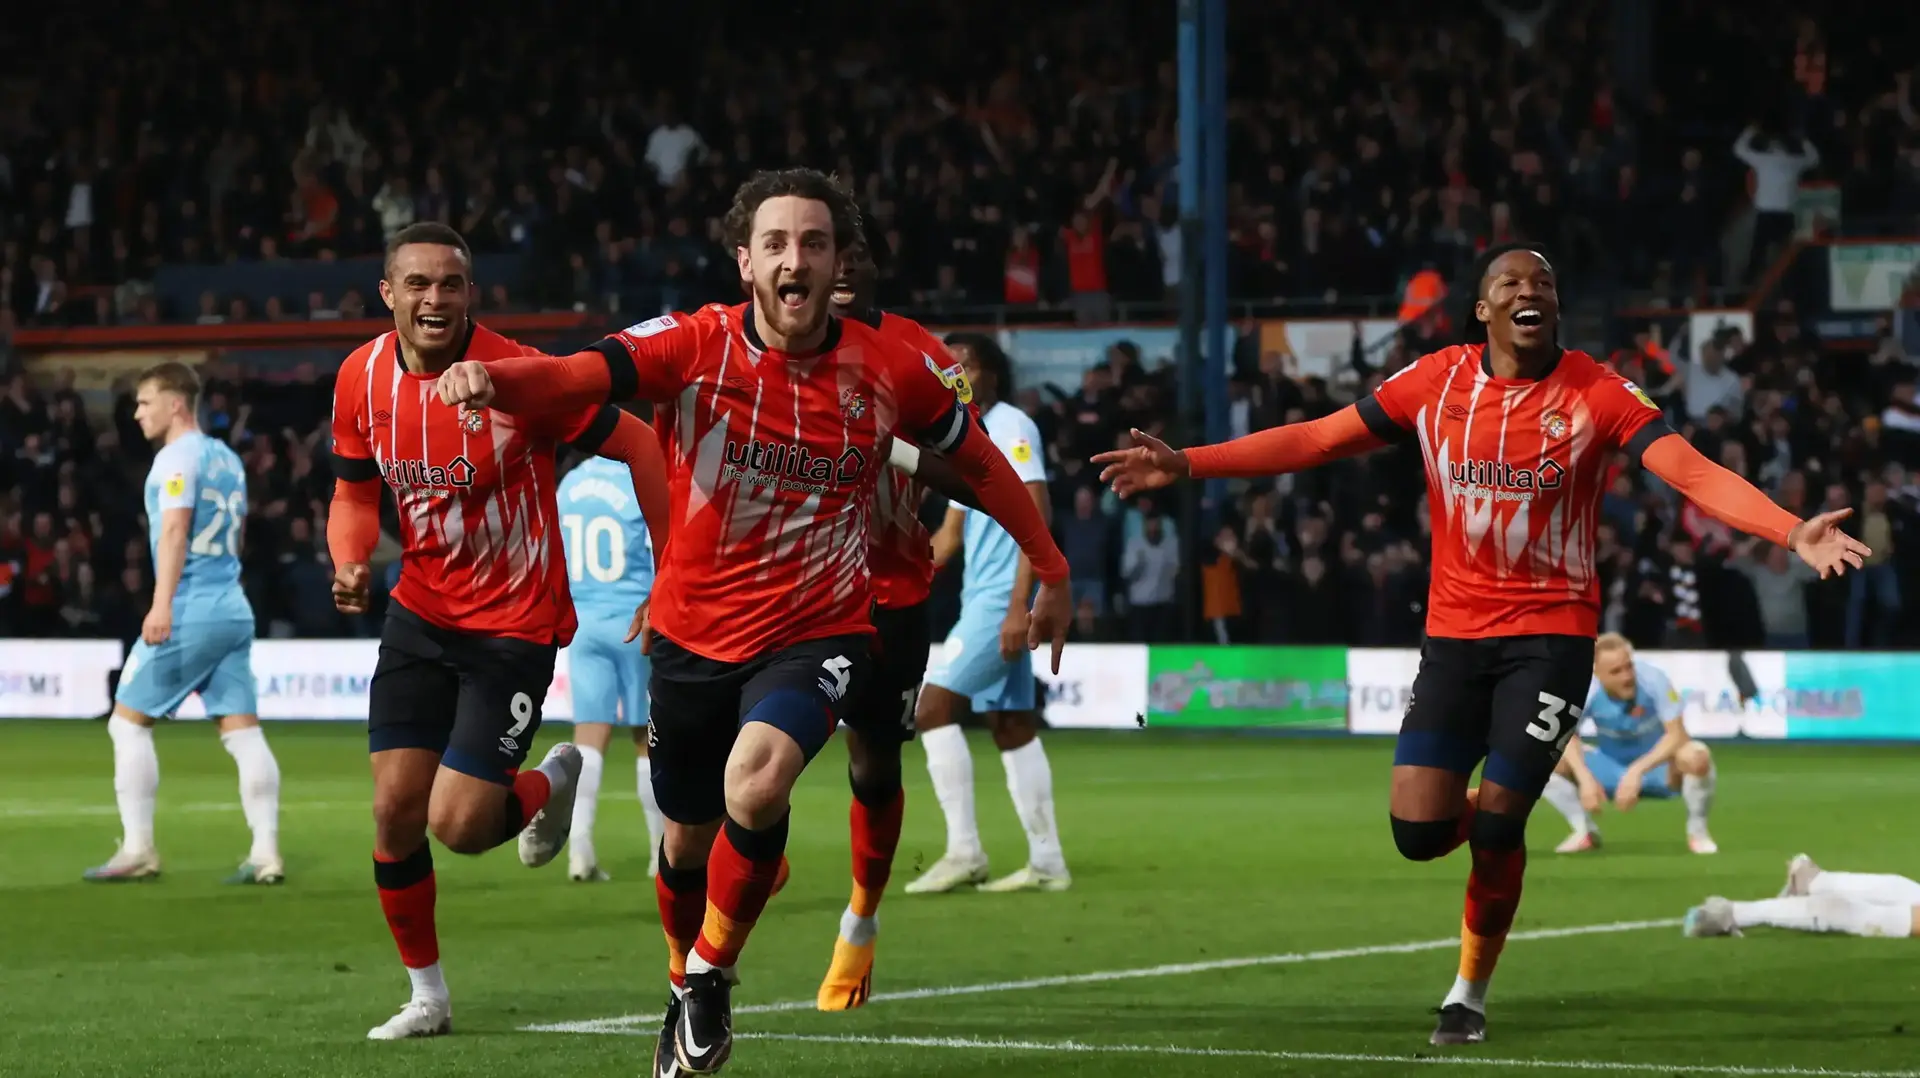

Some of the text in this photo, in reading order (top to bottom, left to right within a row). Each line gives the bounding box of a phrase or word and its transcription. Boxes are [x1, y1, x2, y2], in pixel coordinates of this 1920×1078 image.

[726, 441, 833, 481] utilita
[1450, 459, 1534, 488] utilita
[723, 464, 829, 495] life with power
[1469, 486, 1493, 499] with
[1496, 490, 1534, 502] power
[562, 513, 626, 583] 10
[506, 691, 533, 738] 9
